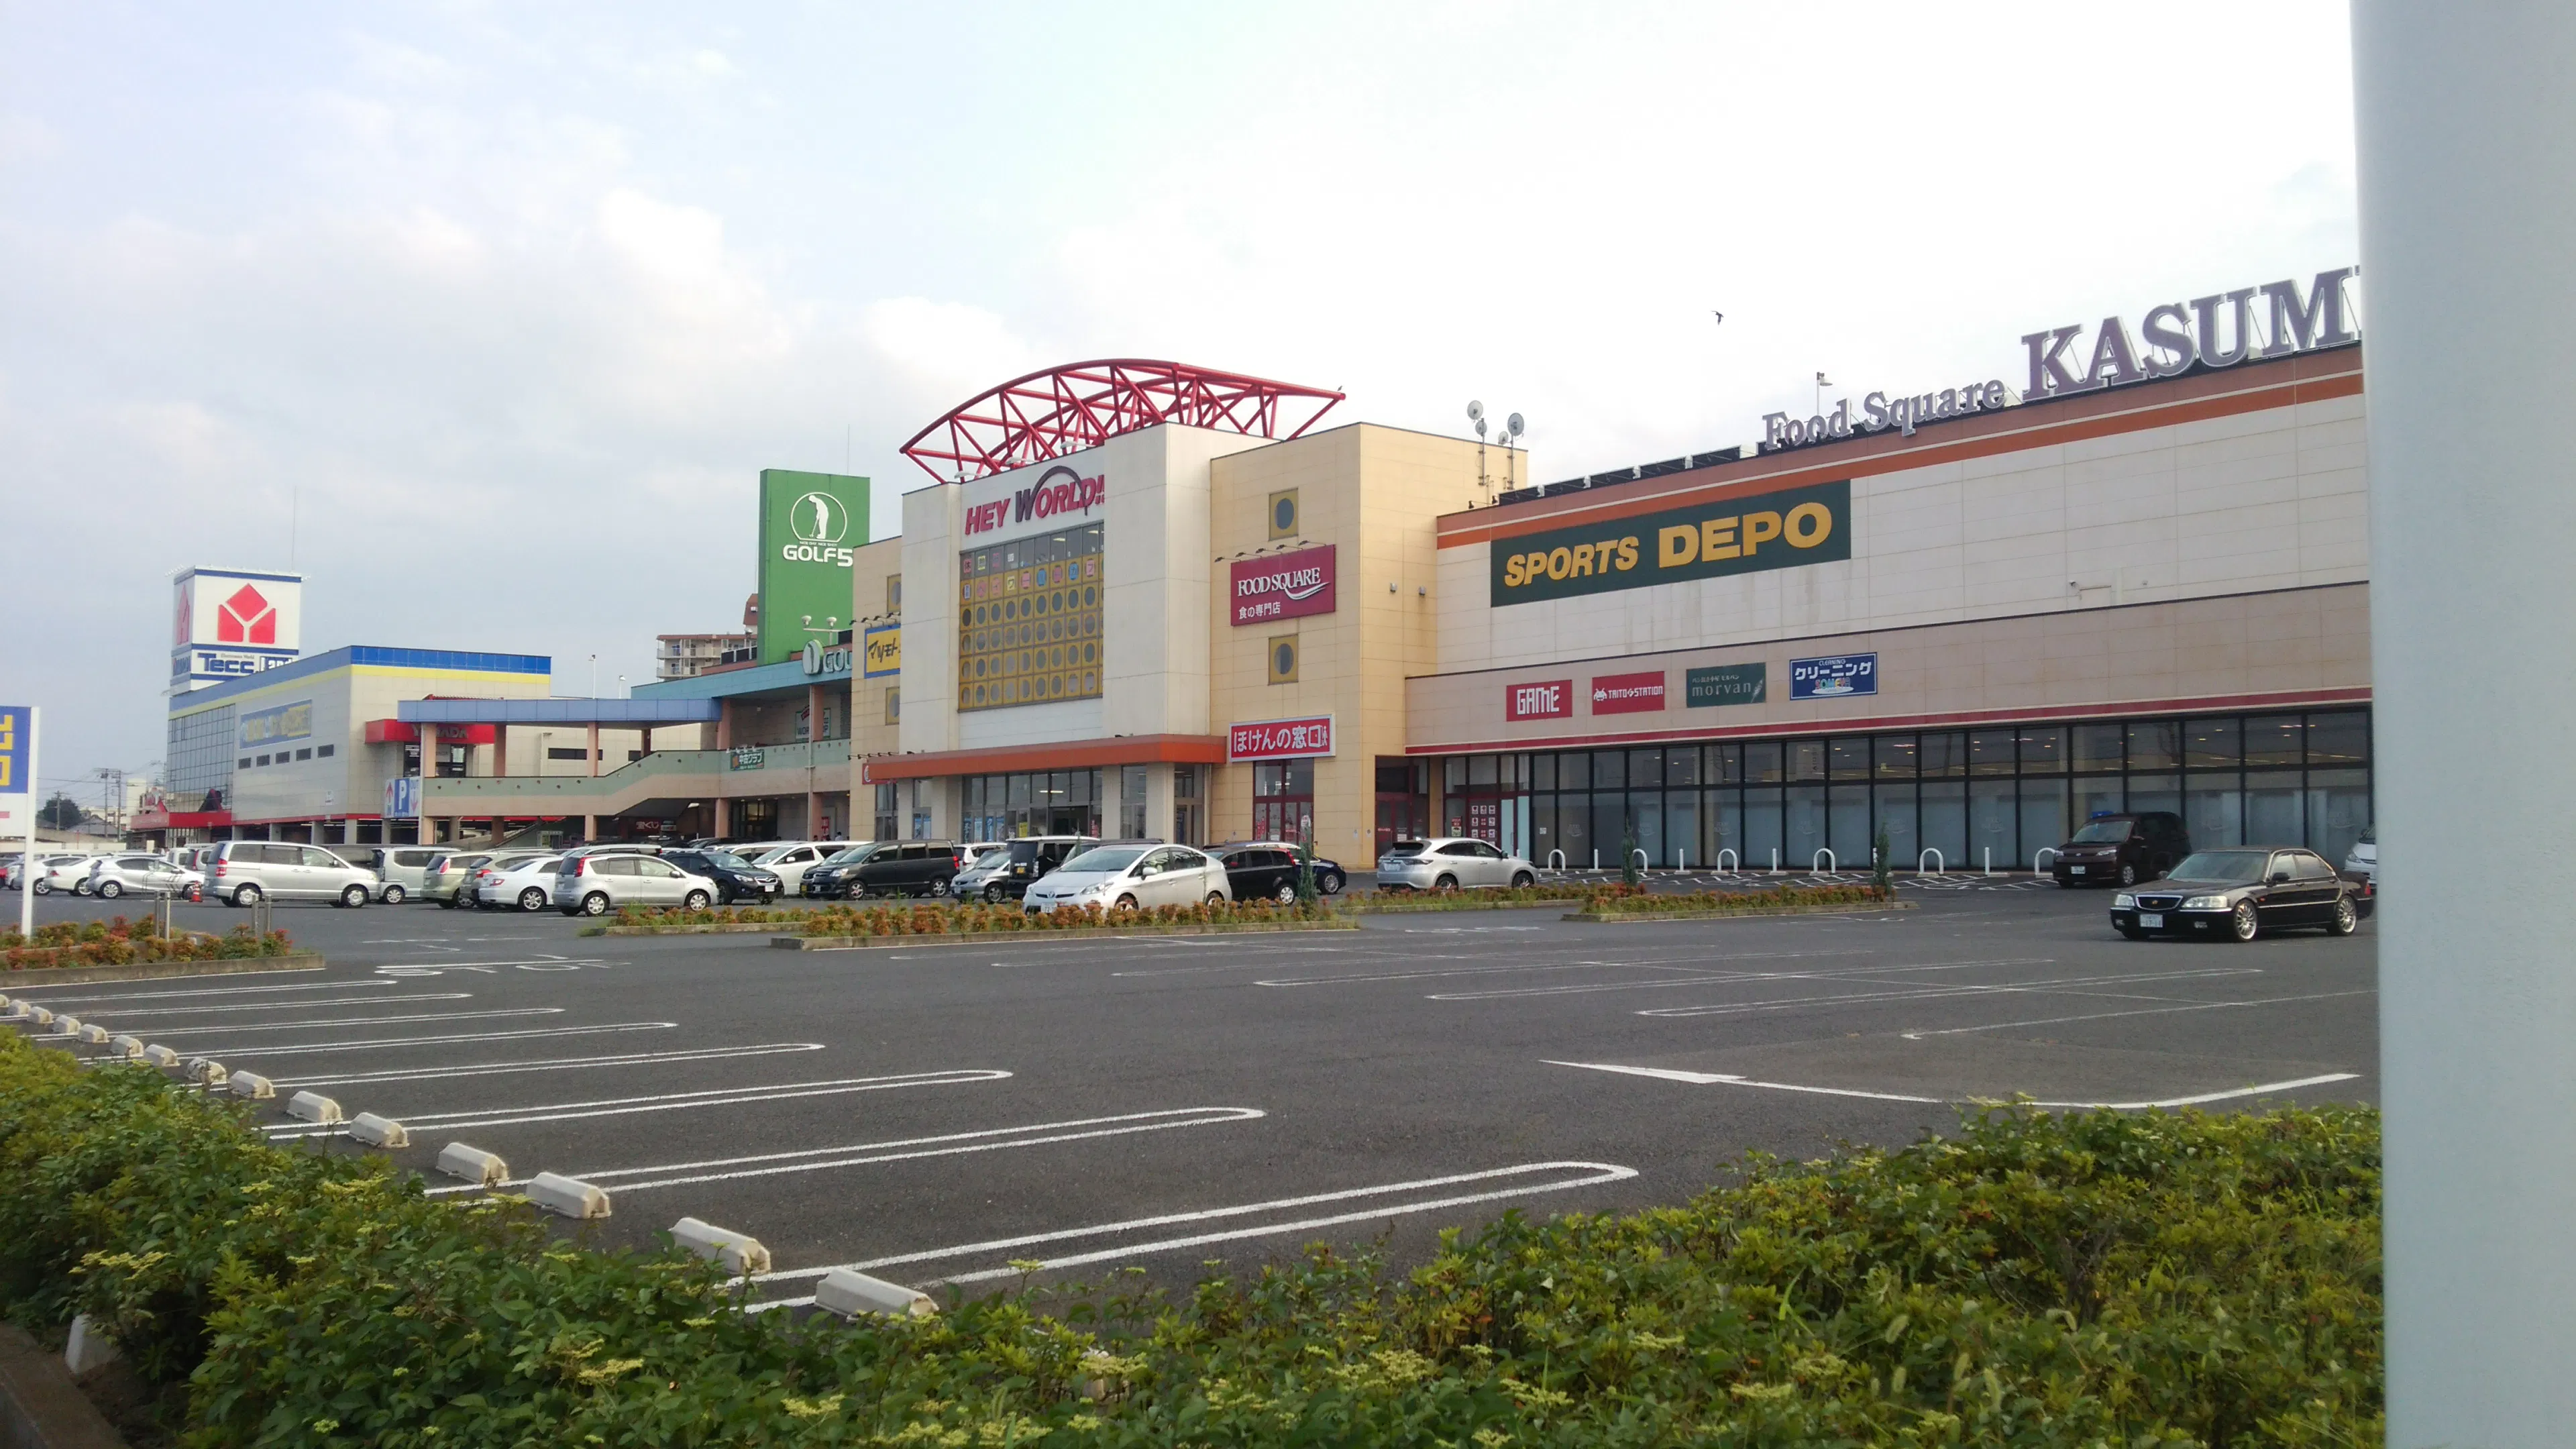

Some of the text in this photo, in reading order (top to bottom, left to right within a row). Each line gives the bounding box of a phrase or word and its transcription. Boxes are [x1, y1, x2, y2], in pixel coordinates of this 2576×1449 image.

[2021, 265, 2360, 403] KASUM
[1762, 378, 2008, 451] Food Square
[965, 498, 1011, 535] HEY
[783, 544, 853, 567] GOLF5
[1504, 502, 1832, 587] SPORTS DEPO
[1238, 568, 1324, 596] FOOD SQUARE
[1239, 602, 1281, 619] 食の専門店
[868, 637, 900, 663] マツモト
[1819, 658, 1846, 666] CLEANING
[197, 652, 254, 674] Tecc
[1795, 661, 1872, 680] クリーニング
[1517, 686, 1560, 715] GAME
[1608, 685, 1664, 699] TAITO STATION
[1692, 682, 1751, 696] morvan
[1234, 724, 1323, 752] ほけんの窓口
[739, 751, 763, 765] 中古クラブ
